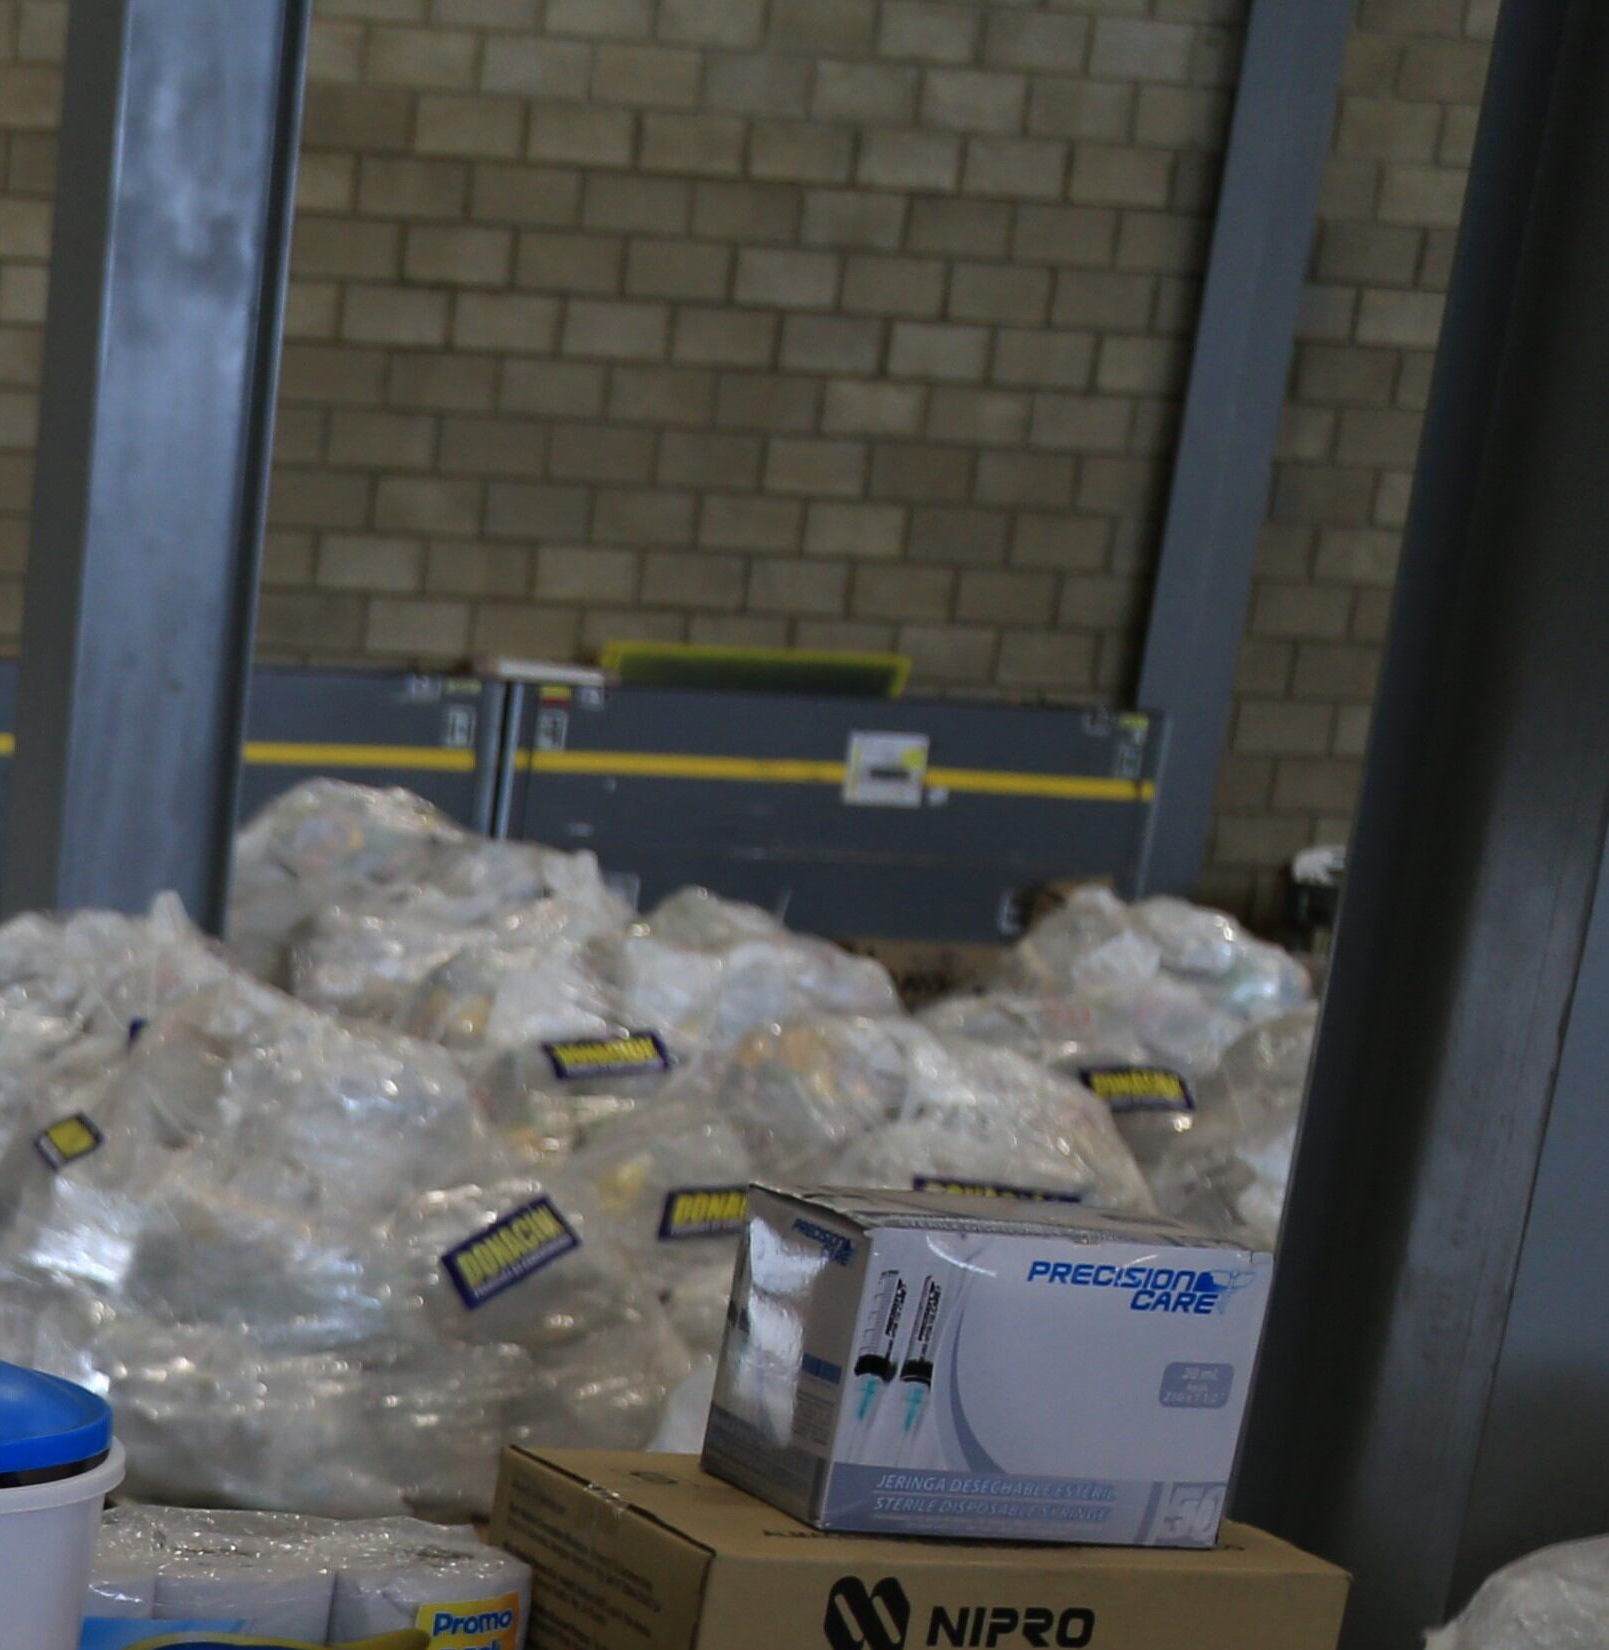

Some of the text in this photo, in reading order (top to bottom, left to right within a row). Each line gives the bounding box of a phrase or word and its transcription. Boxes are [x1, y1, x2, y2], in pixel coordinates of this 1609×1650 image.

[1028, 1262, 1196, 1292] PRECISION
[1131, 1291, 1218, 1314] CARE
[434, 1610, 513, 1635] Promo
[926, 1608, 1095, 1648] NIPRO
